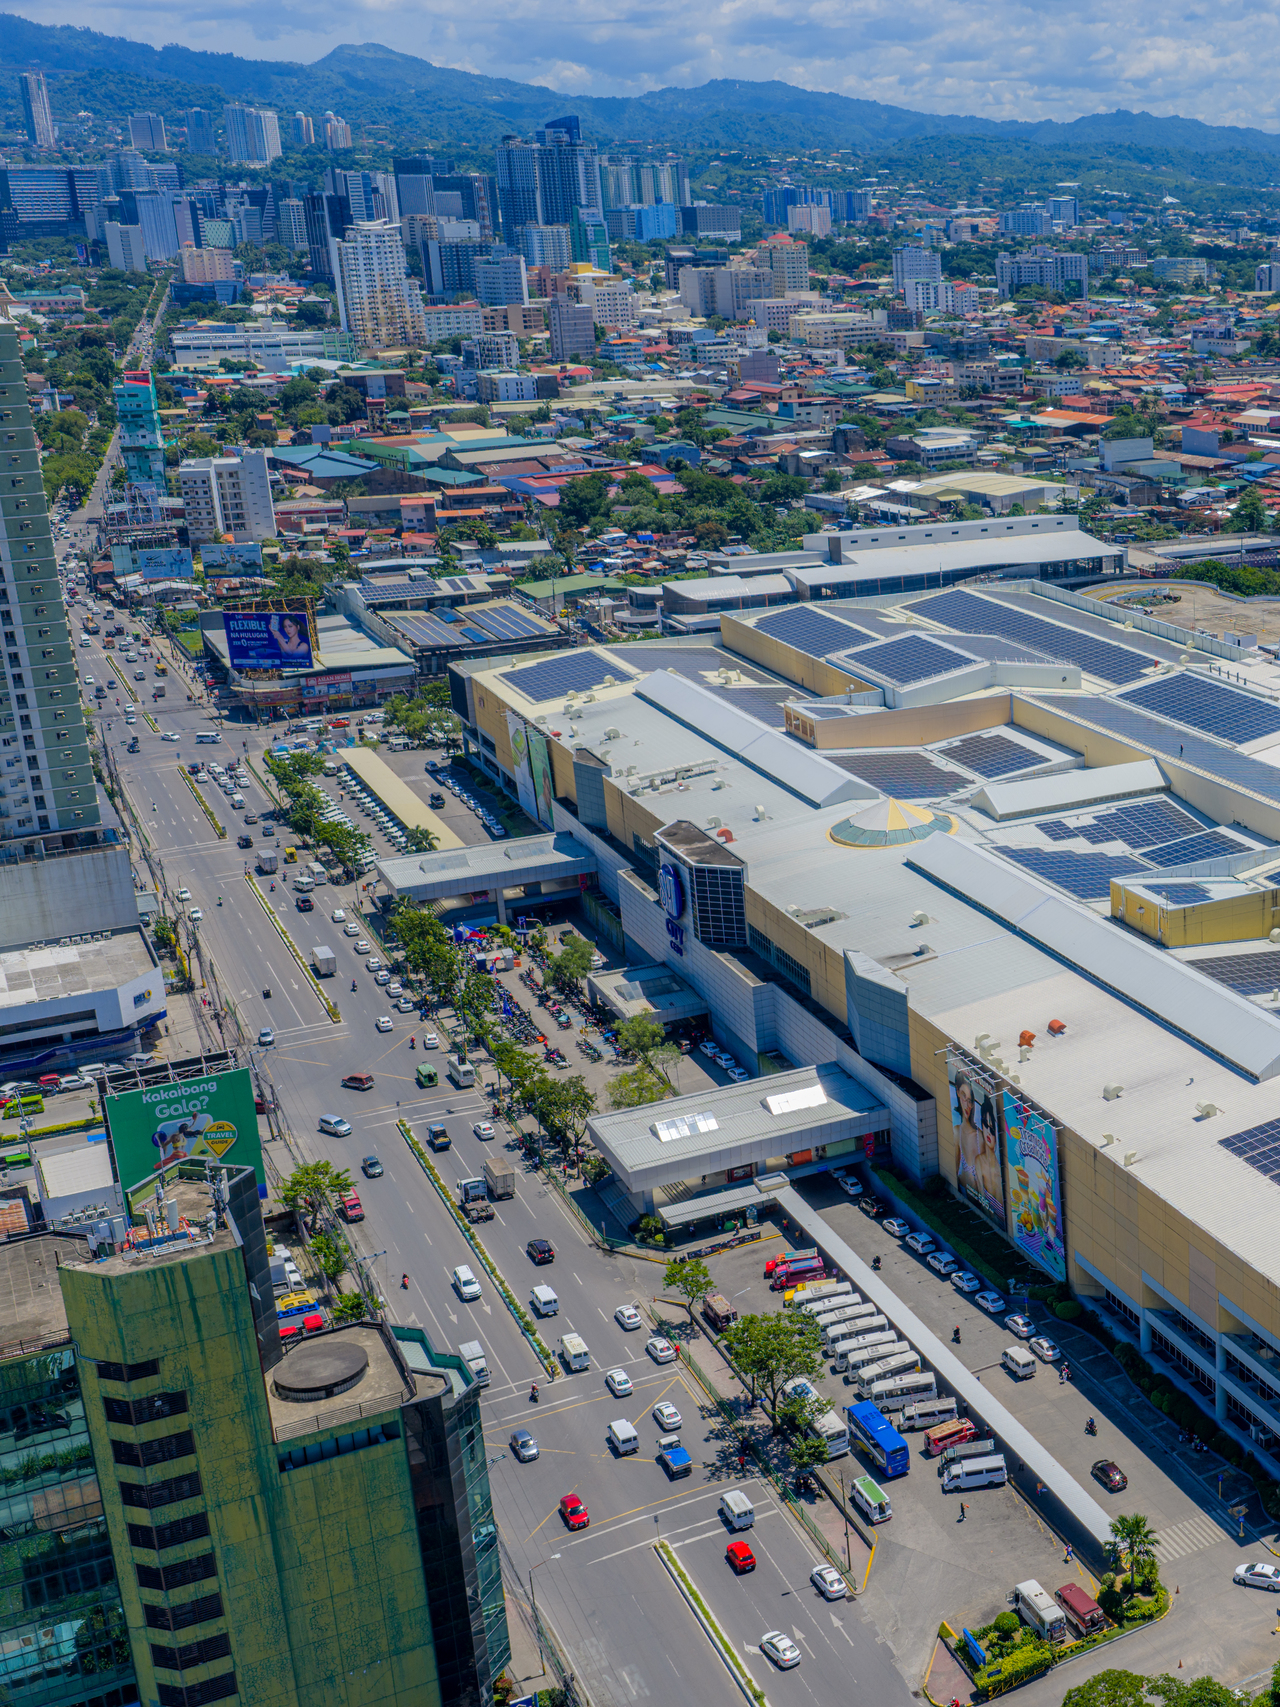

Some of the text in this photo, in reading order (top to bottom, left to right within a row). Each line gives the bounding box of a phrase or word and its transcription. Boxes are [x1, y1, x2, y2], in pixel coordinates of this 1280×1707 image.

[229, 620, 267, 631] FLEXIBLE
[665, 917, 684, 945] CITY
[142, 1081, 218, 1104] Kakaibang
[155, 1095, 210, 1118] Gala?
